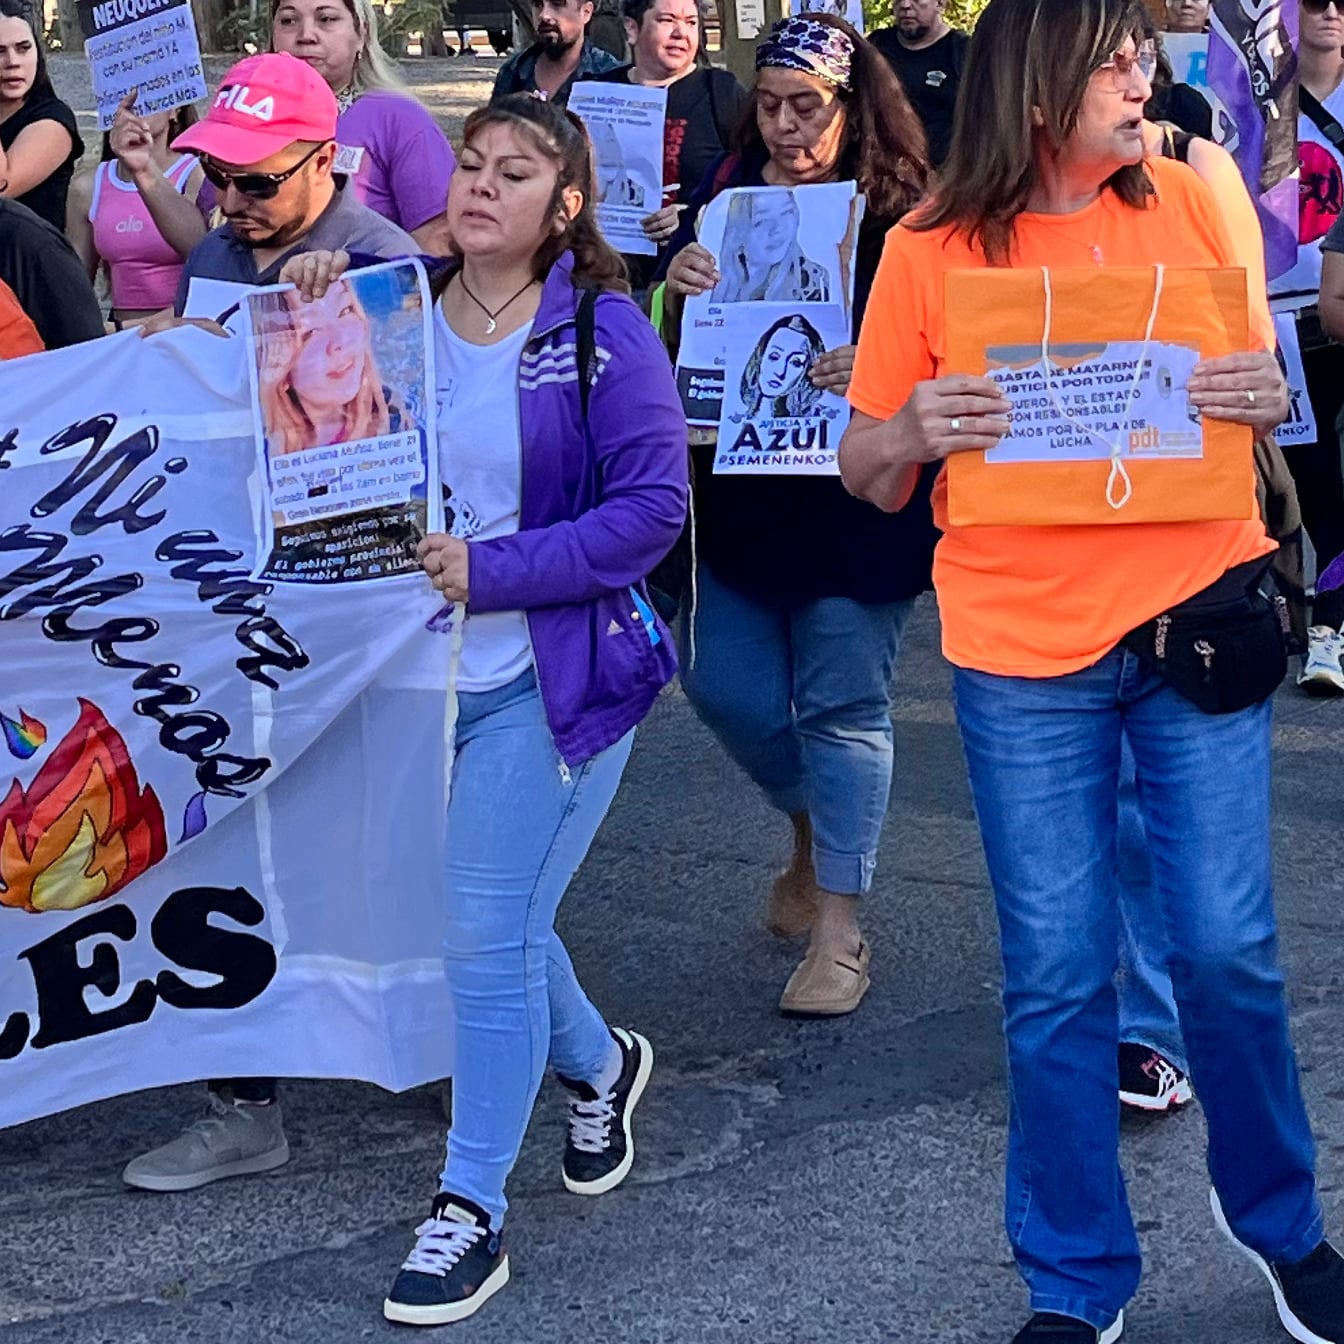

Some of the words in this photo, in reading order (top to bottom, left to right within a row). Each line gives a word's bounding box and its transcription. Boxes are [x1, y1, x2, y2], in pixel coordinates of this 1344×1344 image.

[214, 83, 275, 122] FILA
[993, 368, 1043, 384] BASTA
[1002, 380, 1058, 395] USTICIA
[1061, 376, 1094, 390] POR
[1003, 426, 1044, 440] AMOS
[1046, 423, 1074, 436] POR
[1049, 436, 1093, 449] LUCHA
